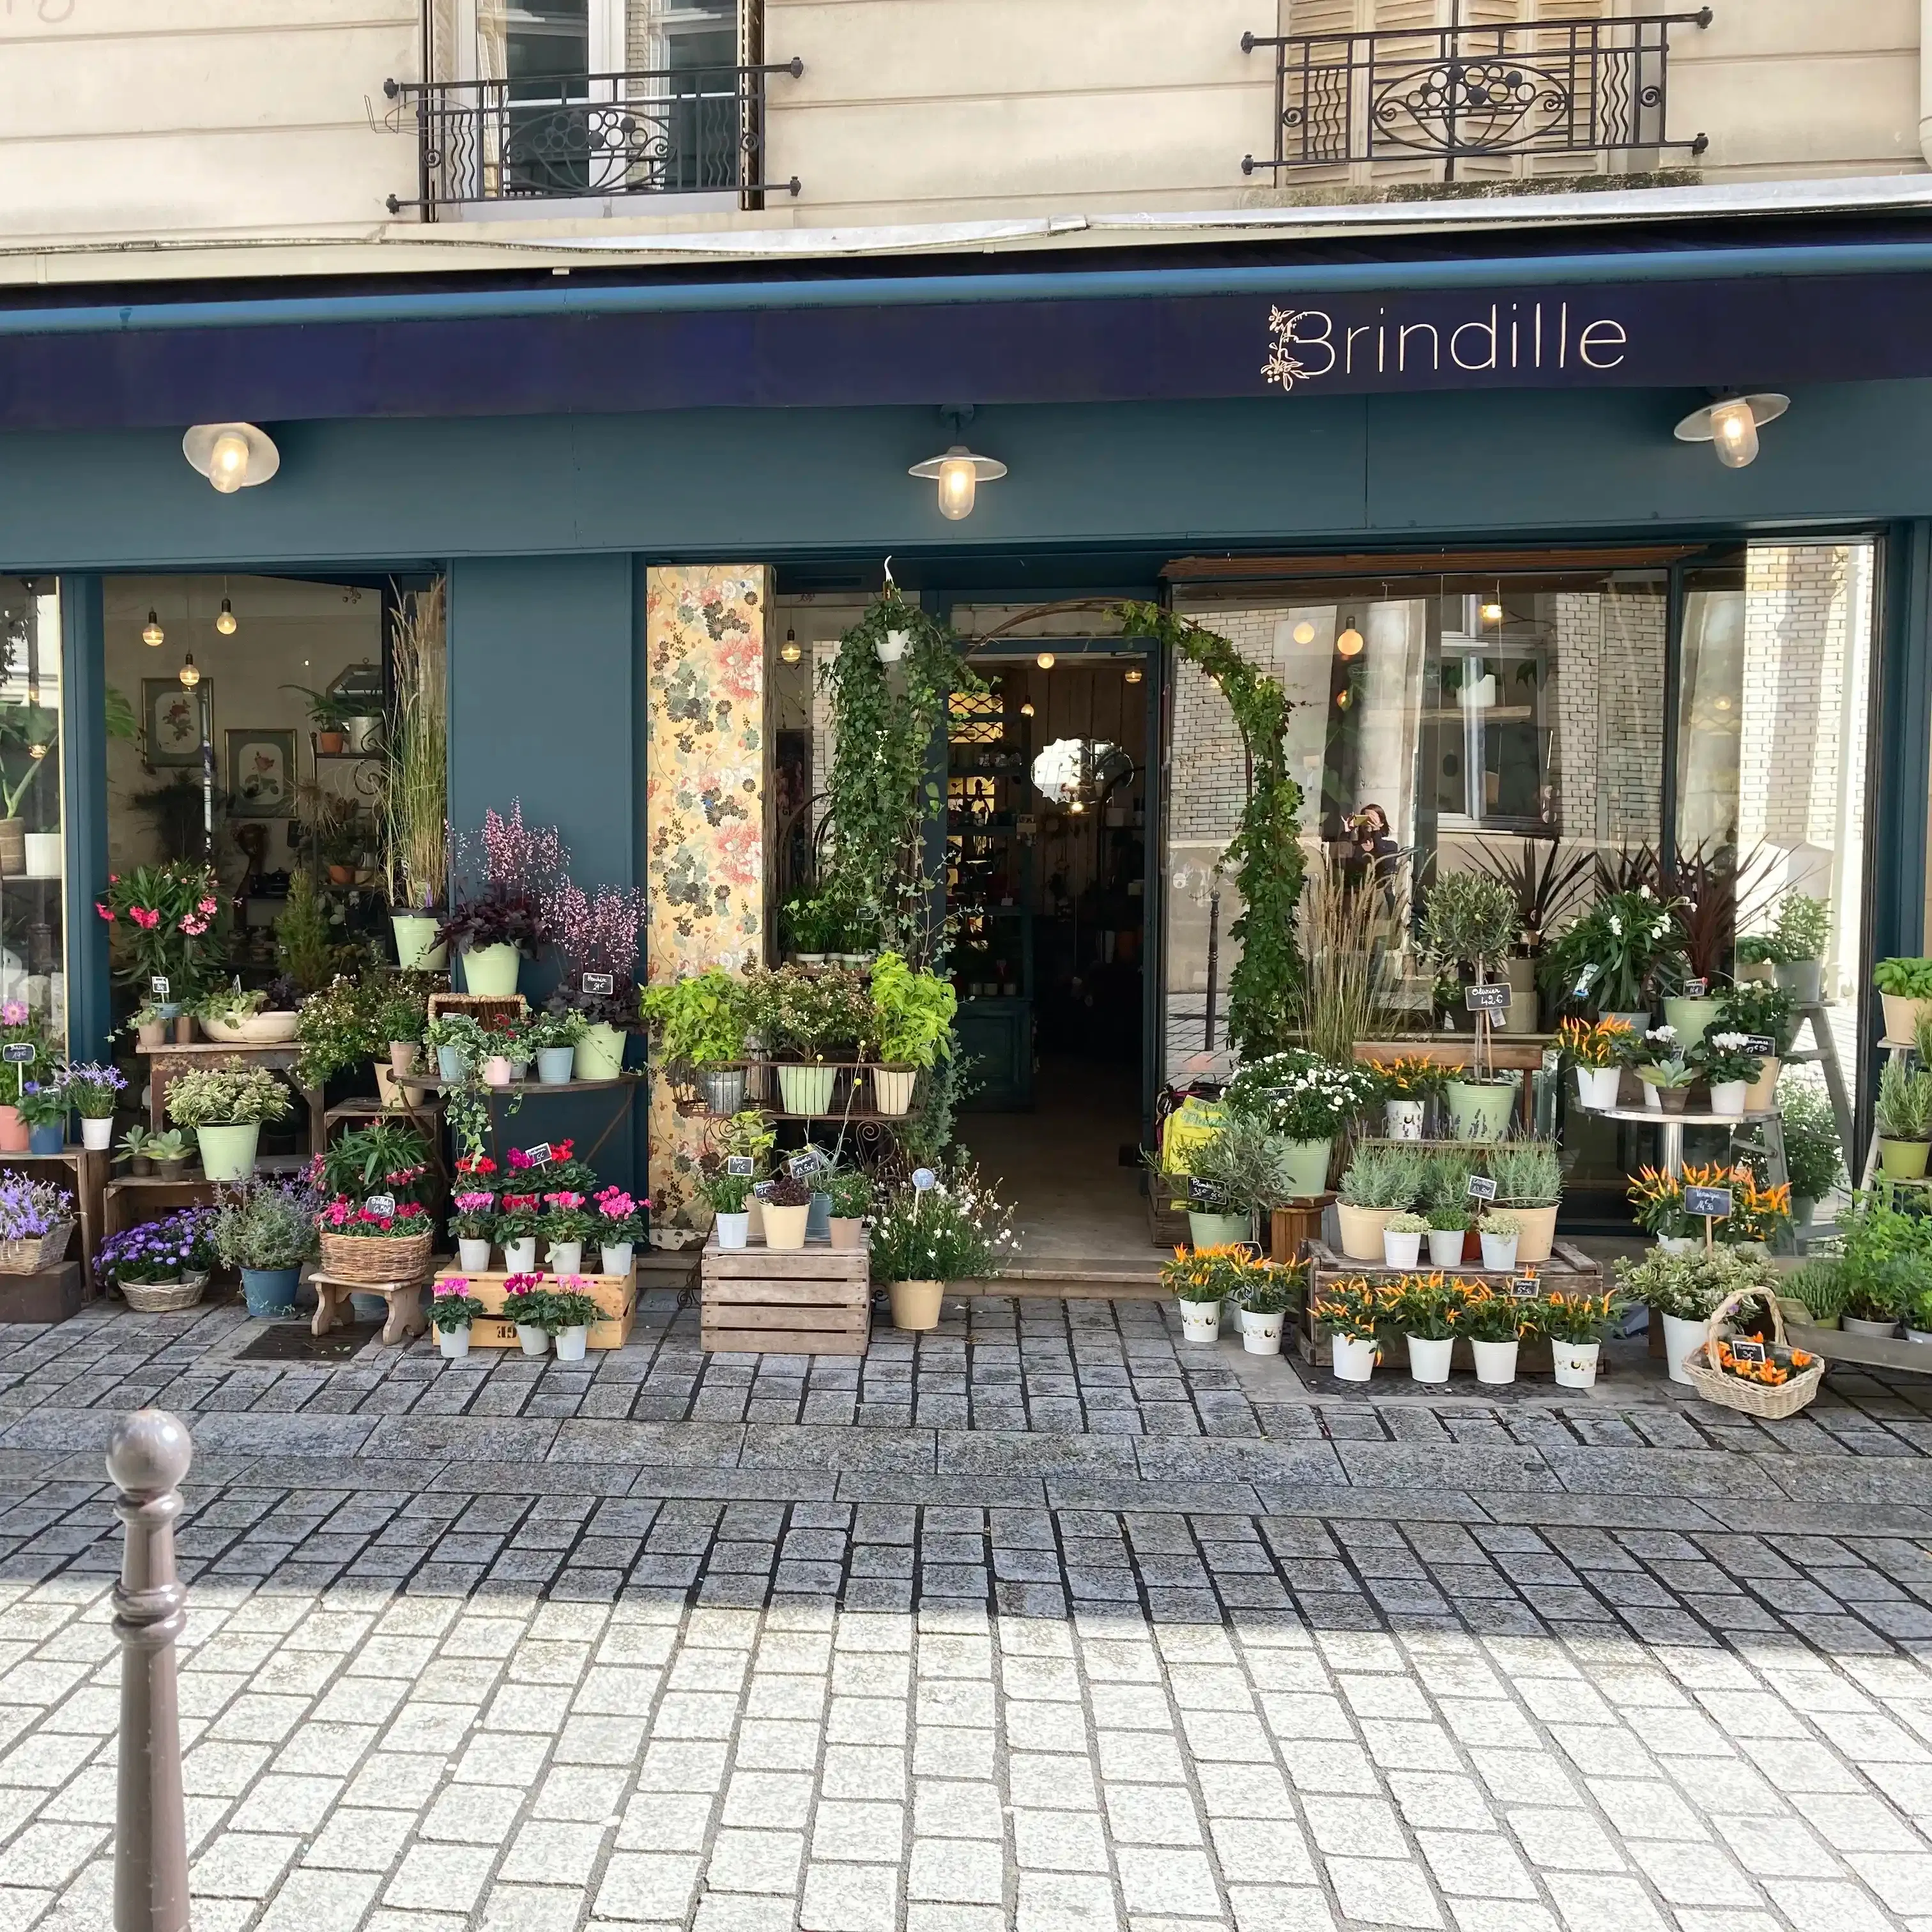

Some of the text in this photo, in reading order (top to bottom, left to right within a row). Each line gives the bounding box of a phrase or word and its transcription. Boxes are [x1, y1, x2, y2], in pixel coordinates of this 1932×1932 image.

[1262, 302, 1627, 391] Brindille
[1481, 994, 1503, 1006] 42€
[737, 1164, 747, 1173] 6€
